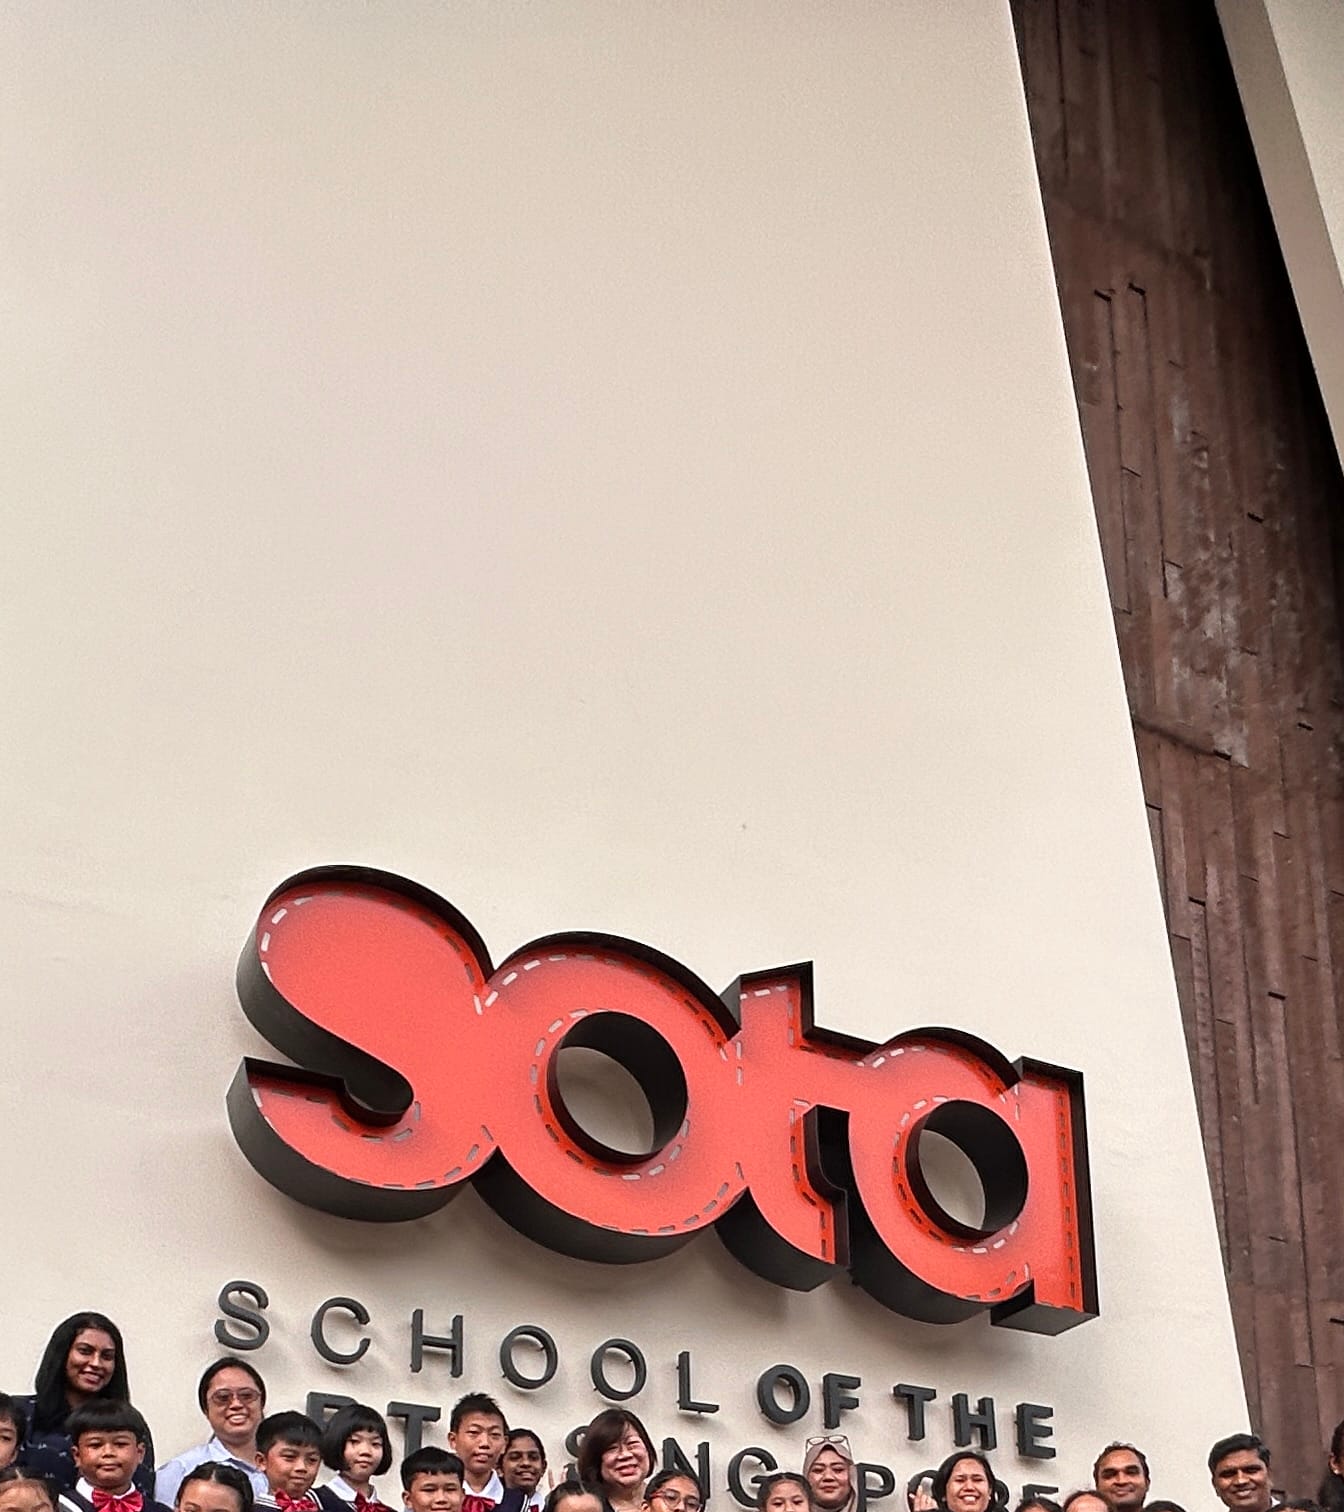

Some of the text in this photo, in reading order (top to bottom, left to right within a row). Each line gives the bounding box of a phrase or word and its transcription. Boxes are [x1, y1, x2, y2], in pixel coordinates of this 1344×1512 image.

[214, 1280, 1056, 1459] SCHOOL OF THE
